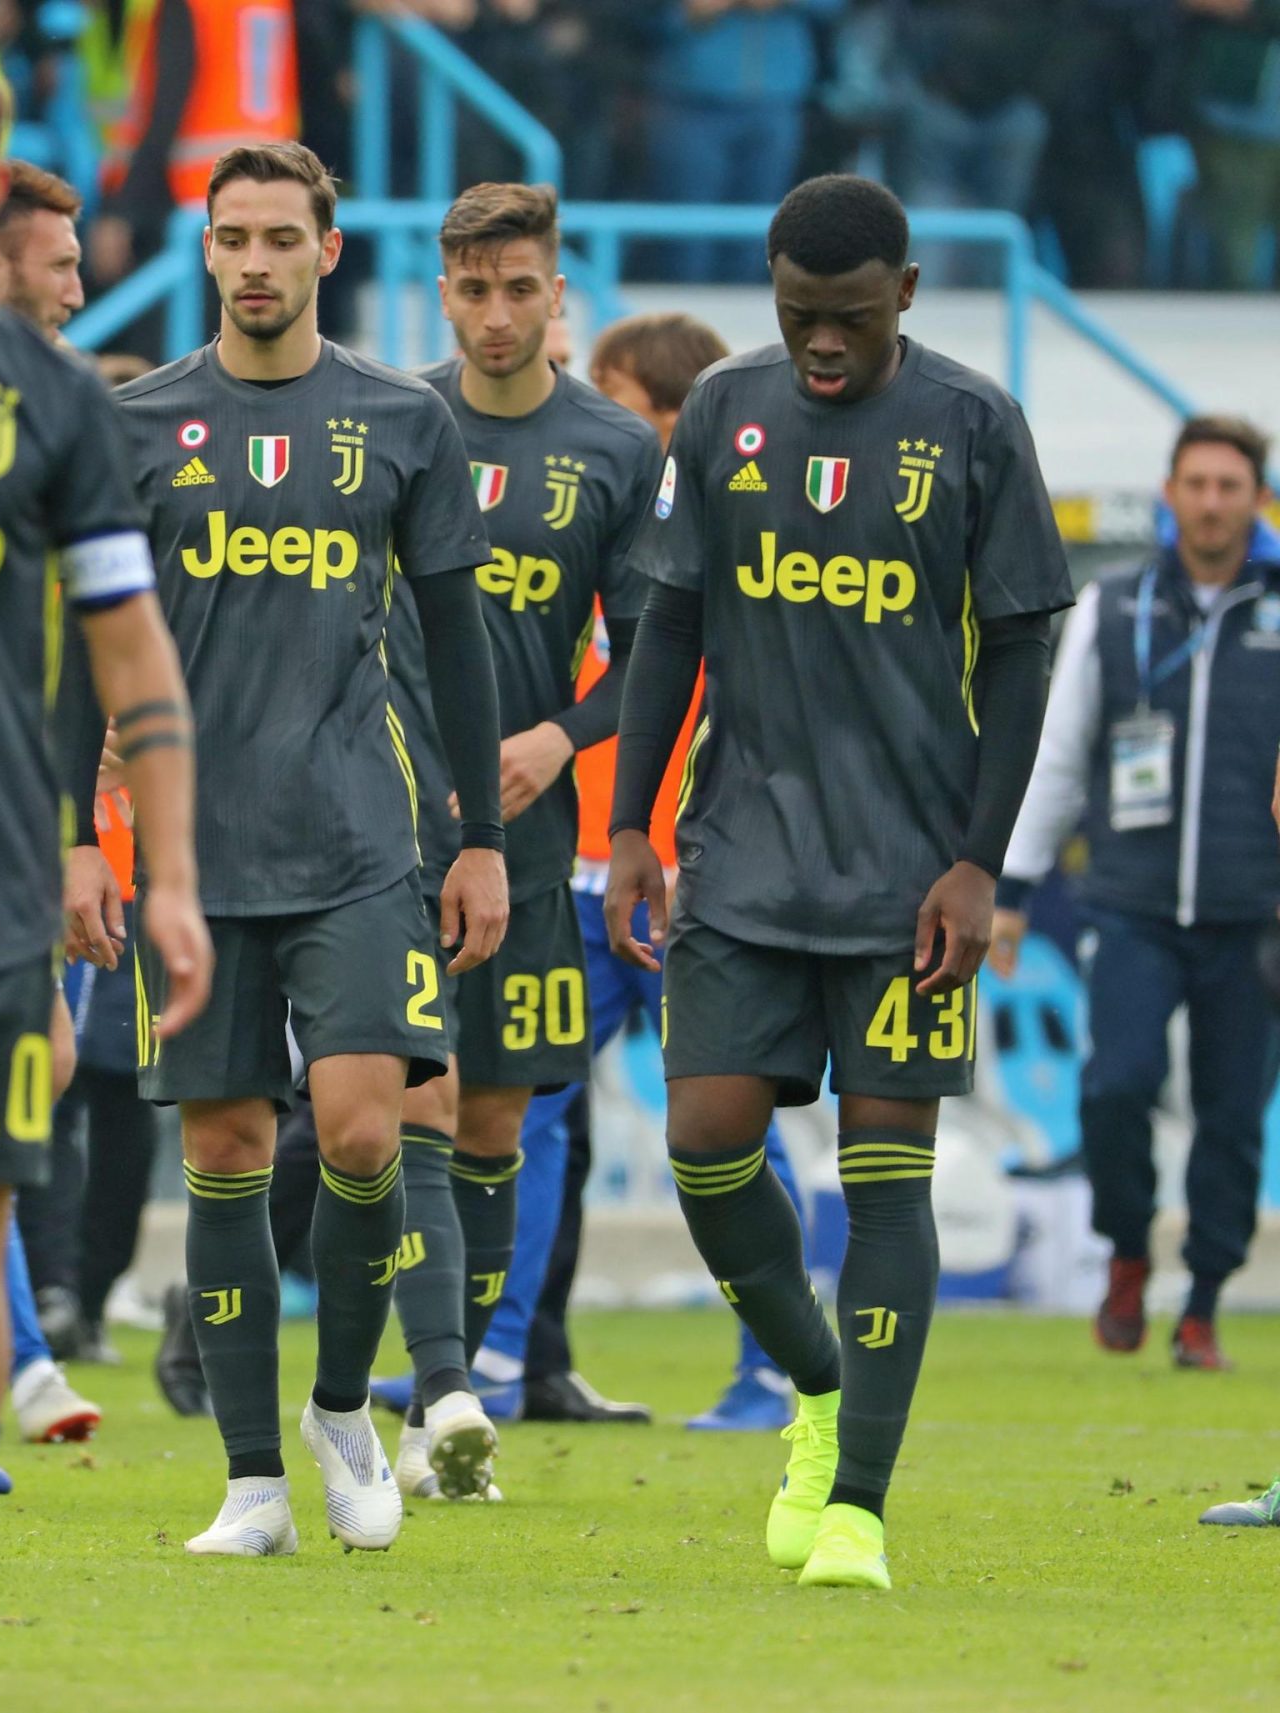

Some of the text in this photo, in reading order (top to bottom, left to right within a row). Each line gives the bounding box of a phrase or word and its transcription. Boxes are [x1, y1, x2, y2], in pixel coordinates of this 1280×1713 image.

[171, 473, 216, 488] adidas
[728, 479, 769, 492] adidas
[181, 510, 359, 590] Jeep
[474, 546, 561, 613] ep
[736, 530, 917, 624] Jeep
[405, 949, 443, 1030] 2
[502, 966, 586, 1051] 30
[865, 975, 965, 1063] 43
